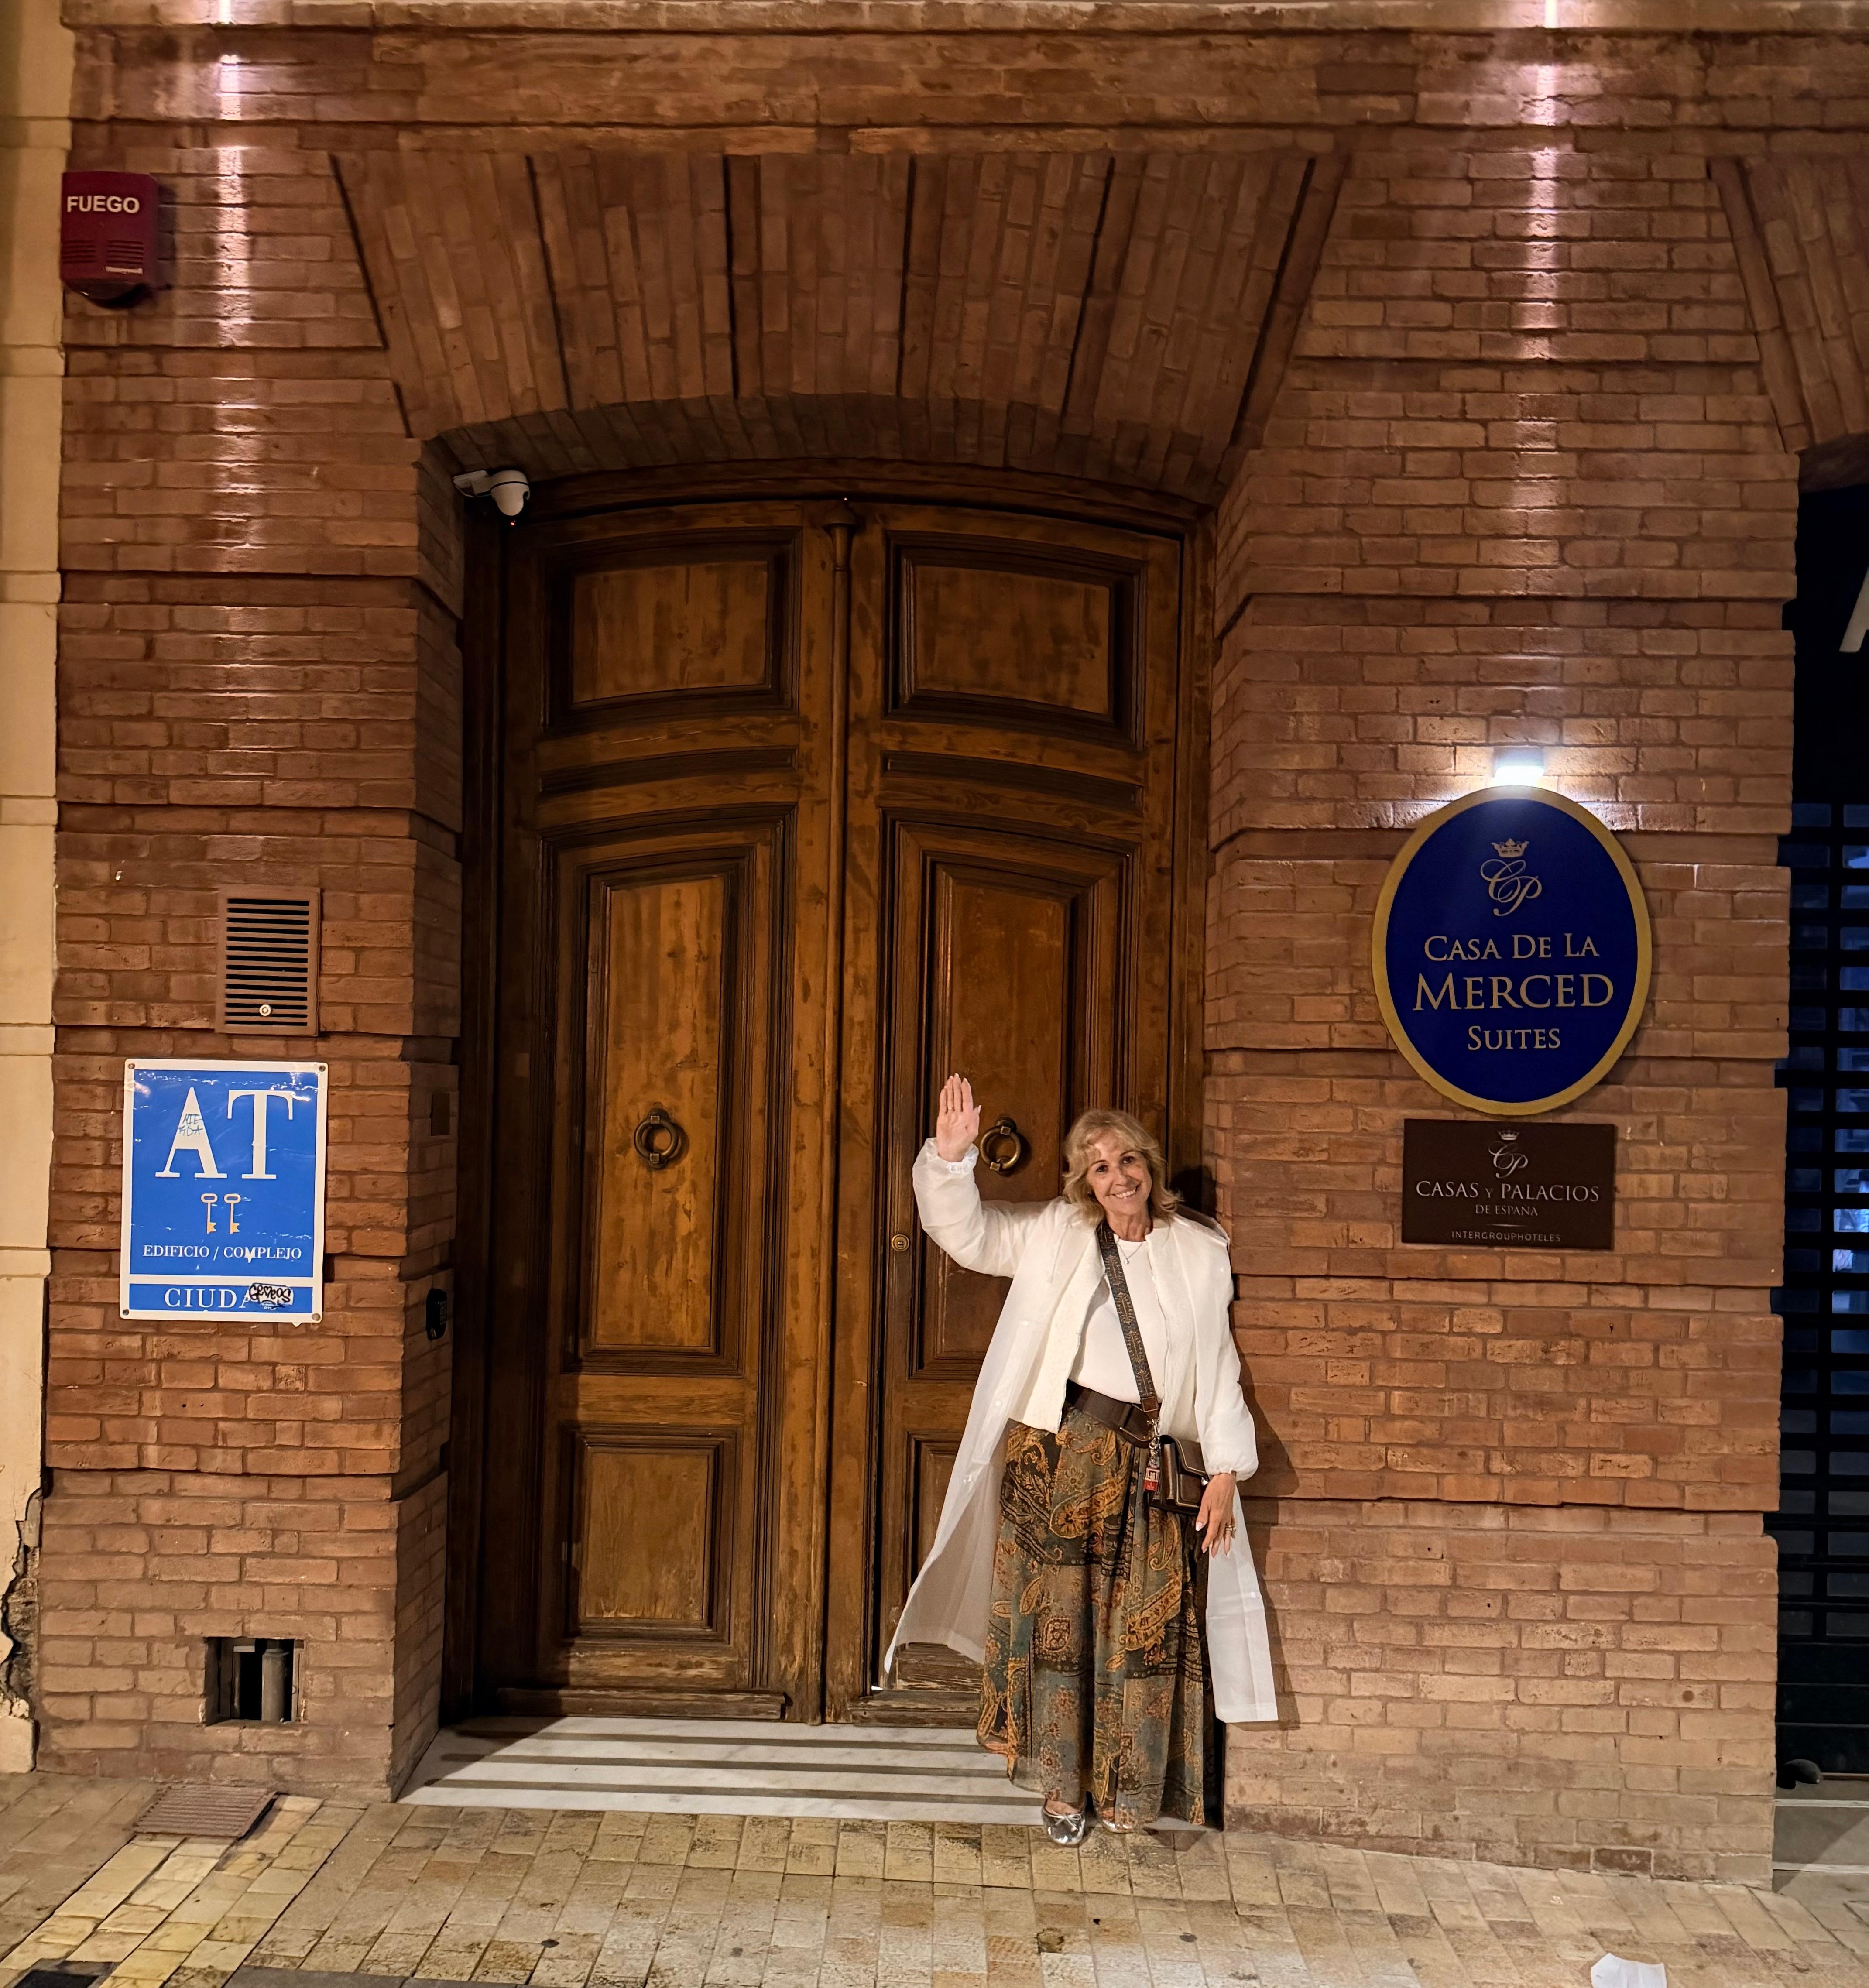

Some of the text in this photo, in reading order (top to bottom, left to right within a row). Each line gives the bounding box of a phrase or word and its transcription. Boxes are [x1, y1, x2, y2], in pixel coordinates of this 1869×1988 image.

[67, 195, 140, 213] FUEGO
[1424, 933, 1600, 961] CASA DE LA
[1412, 972, 1614, 1011] MERCED
[1468, 1025, 1560, 1050] SUITES
[155, 1087, 294, 1179] AT
[1416, 1181, 1478, 1198] CASAS
[1502, 1183, 1600, 1202] PALACIOS
[1475, 1204, 1490, 1214] DE
[143, 1244, 210, 1258] EDIFICIO
[223, 1246, 302, 1260] COMPLEJO
